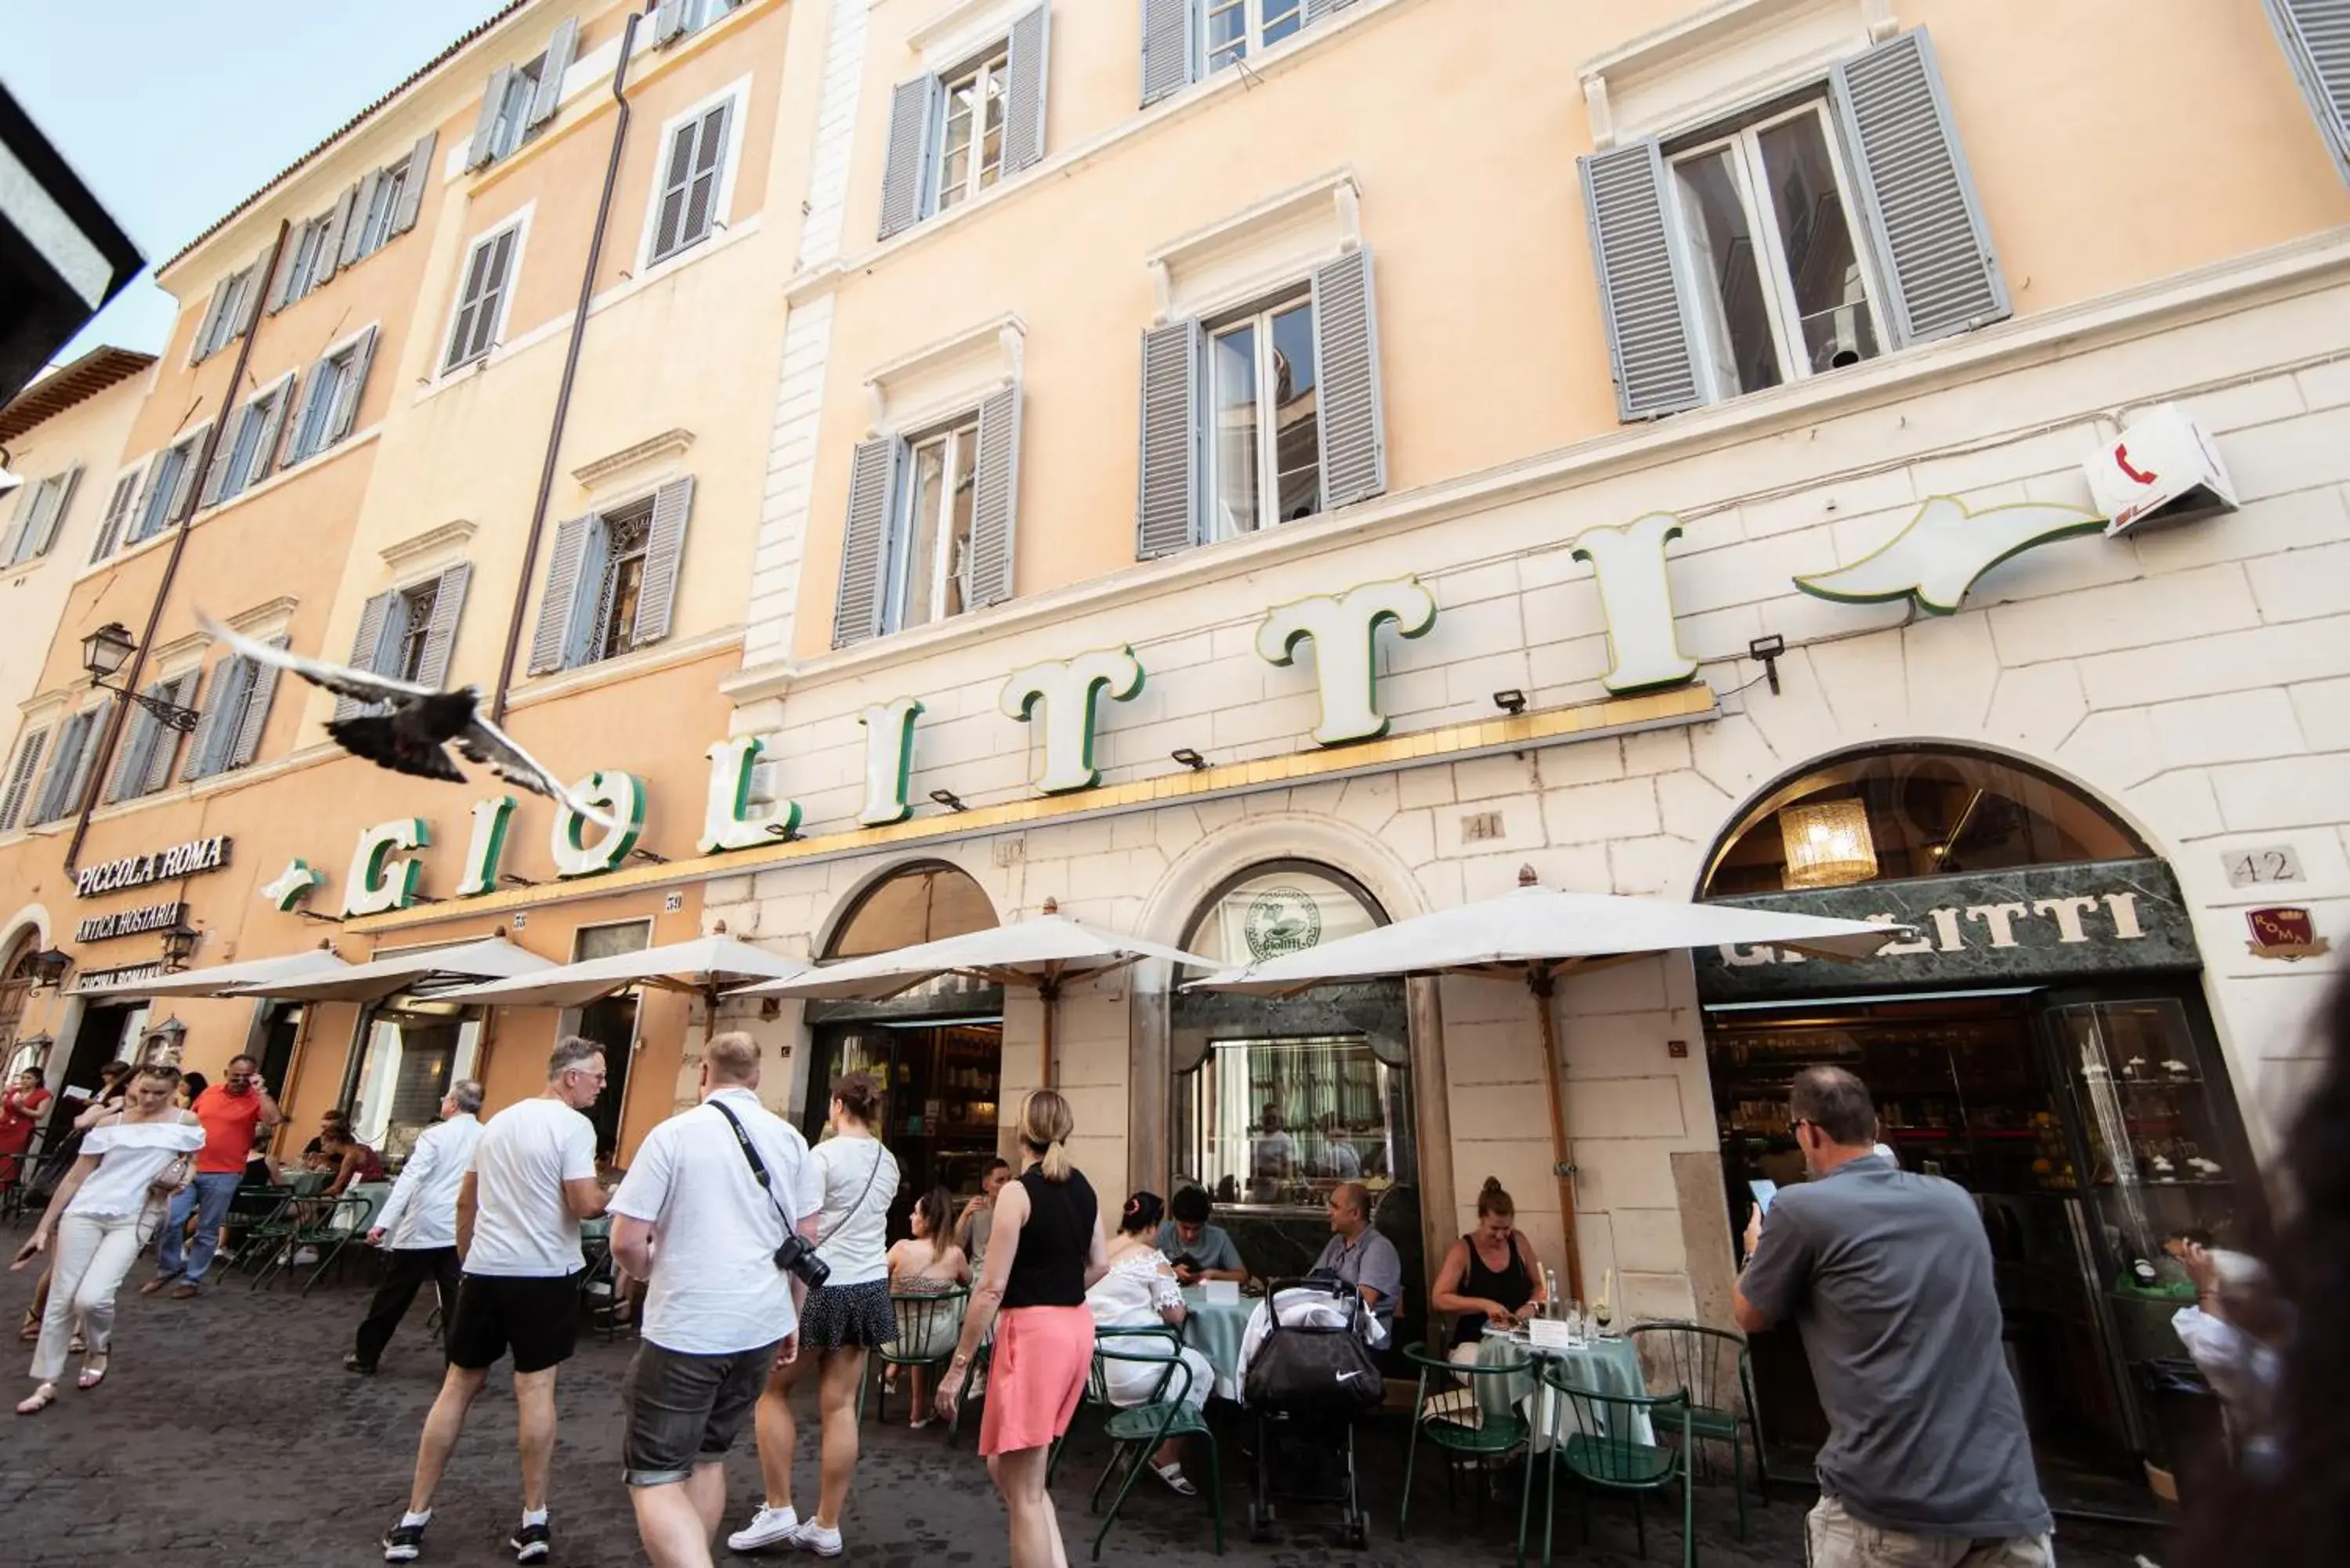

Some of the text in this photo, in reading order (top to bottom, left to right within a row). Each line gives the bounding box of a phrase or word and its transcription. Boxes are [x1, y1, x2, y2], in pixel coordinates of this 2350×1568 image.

[342, 511, 1698, 916] GIOLITTI
[1469, 814, 1497, 838] 41
[74, 835, 224, 896] PICCOLA ROMA
[2233, 851, 2294, 883] 42
[76, 902, 179, 941] ANTICA HOSTARIA
[2254, 914, 2305, 945] ROMA
